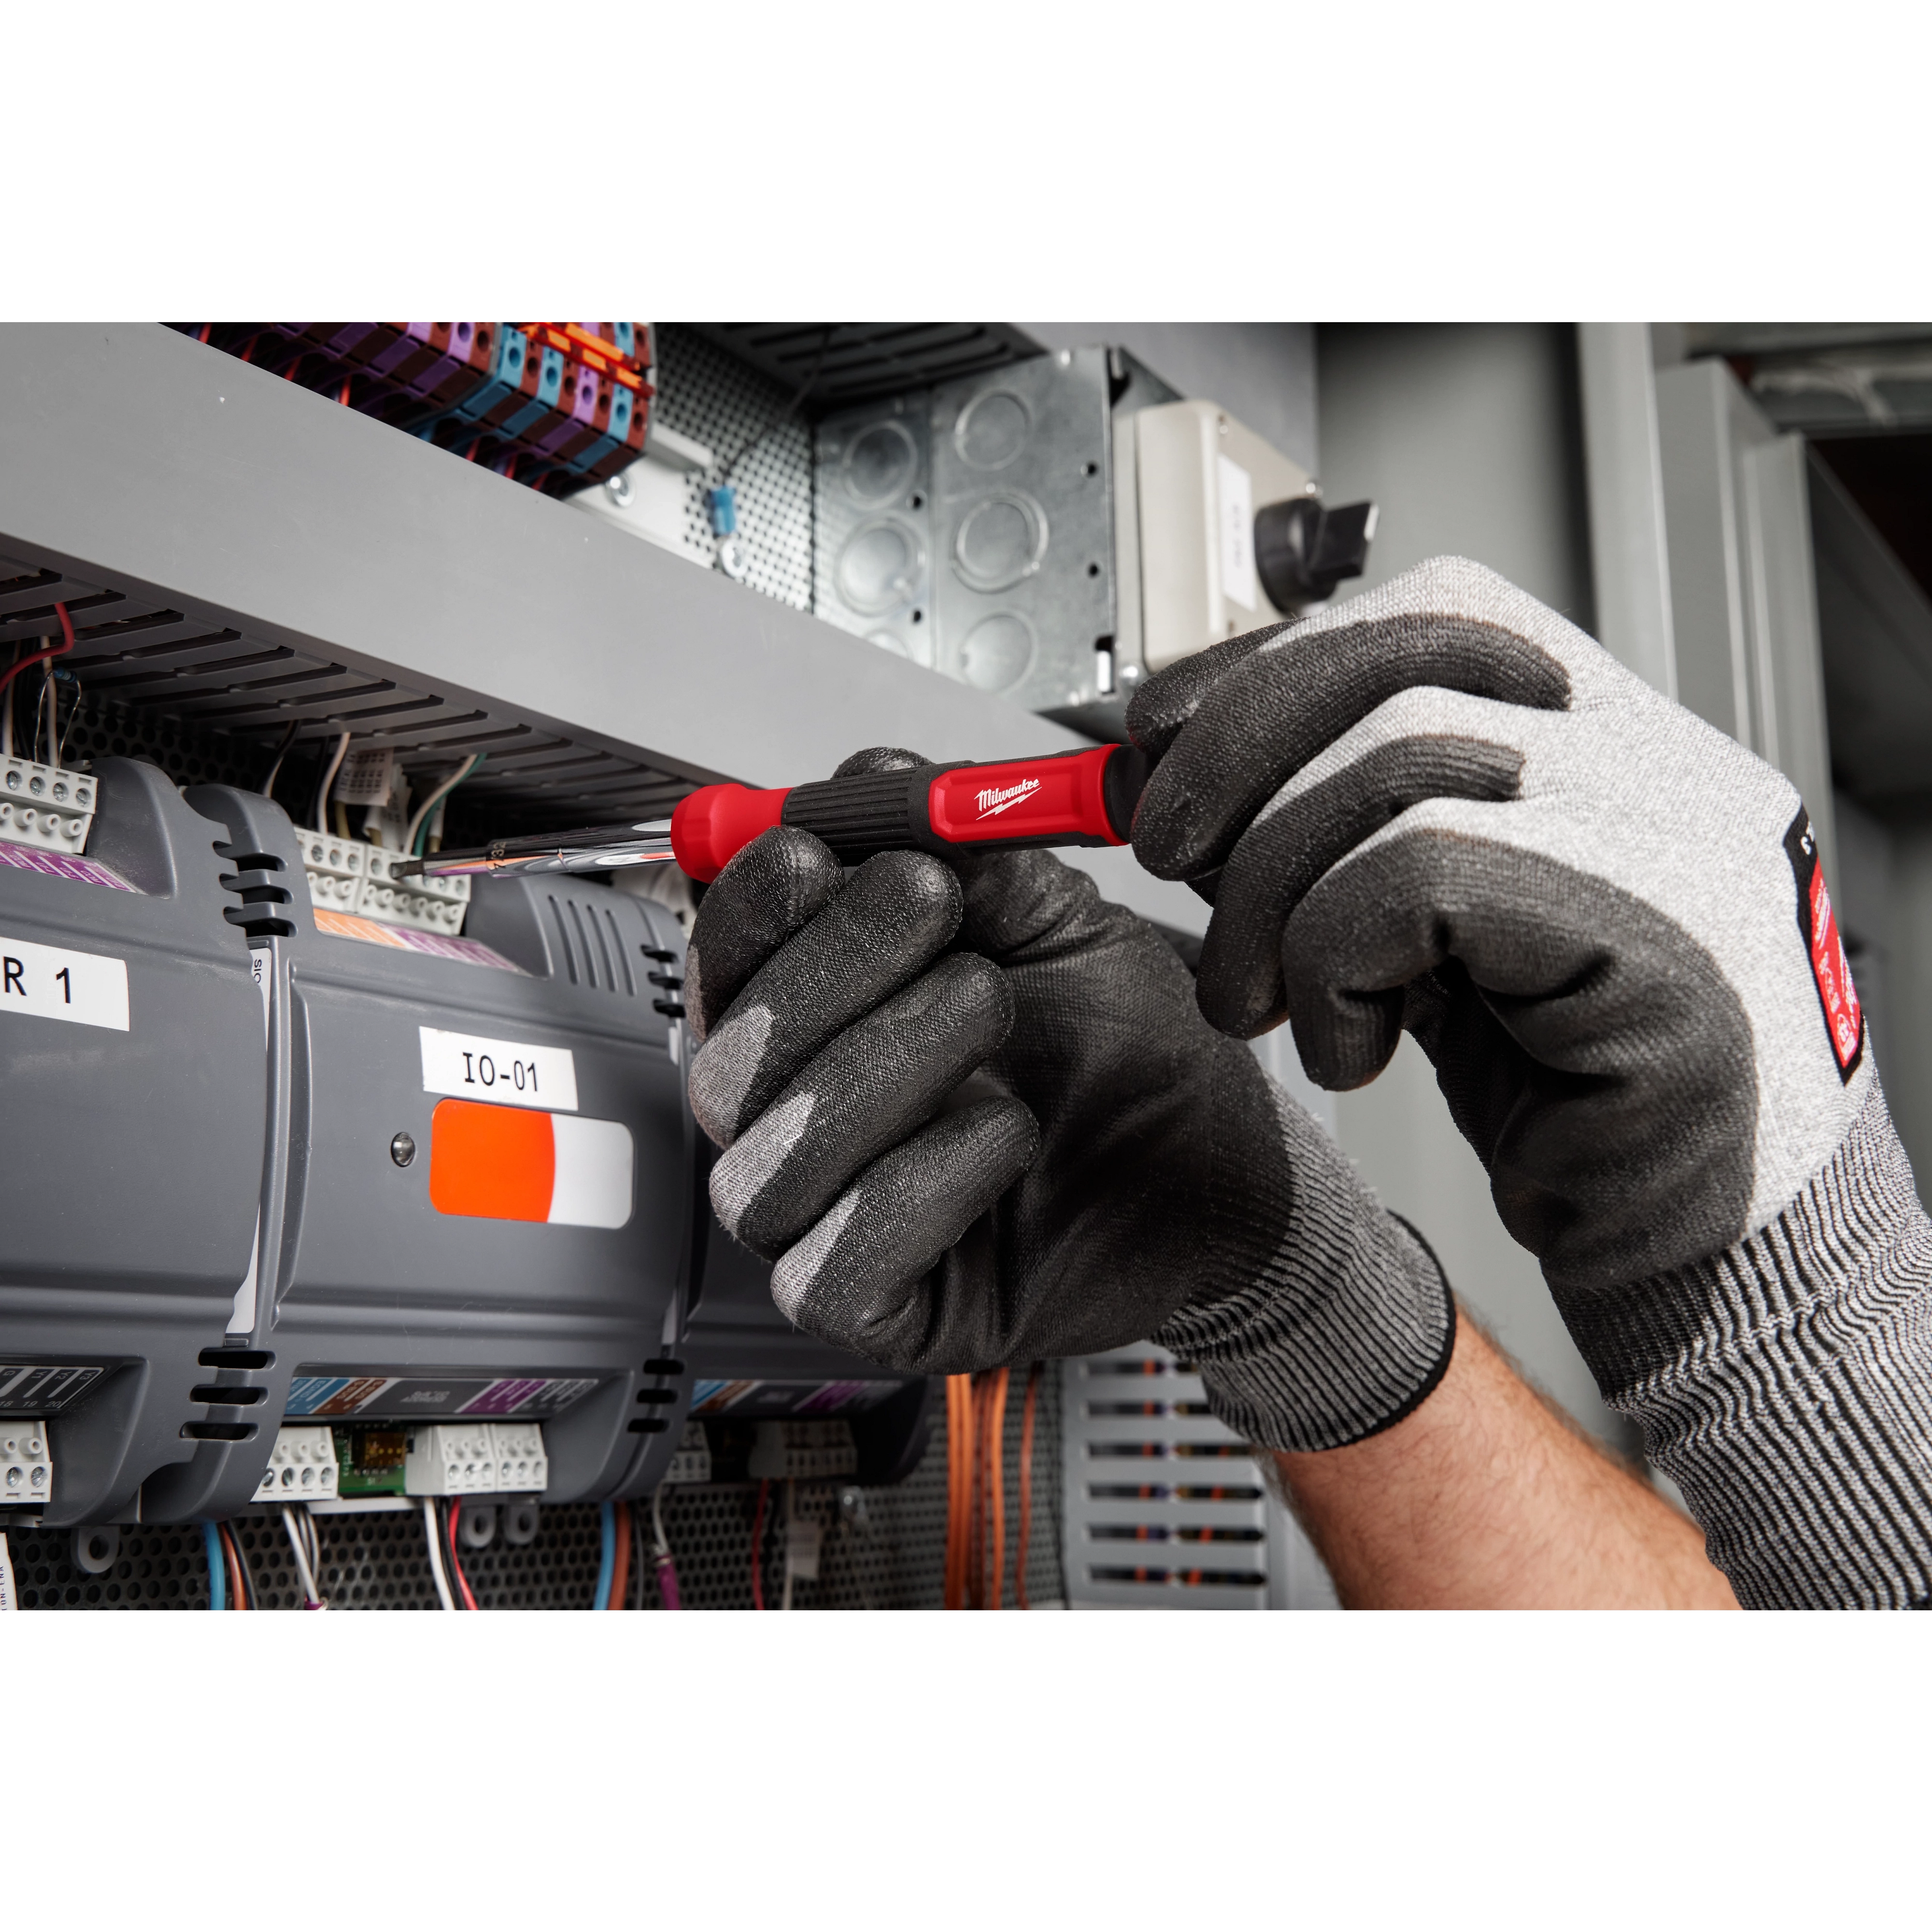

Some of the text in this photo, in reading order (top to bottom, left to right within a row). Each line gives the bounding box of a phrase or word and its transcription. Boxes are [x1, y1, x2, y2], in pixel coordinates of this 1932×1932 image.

[974, 779, 1040, 811] Milwaukee
[80, 870, 102, 883] COM
[3, 956, 71, 1004] R 1
[462, 1051, 538, 1092] IO-01
[55, 1371, 72, 1380] Y2
[79, 1371, 95, 1380] Y3
